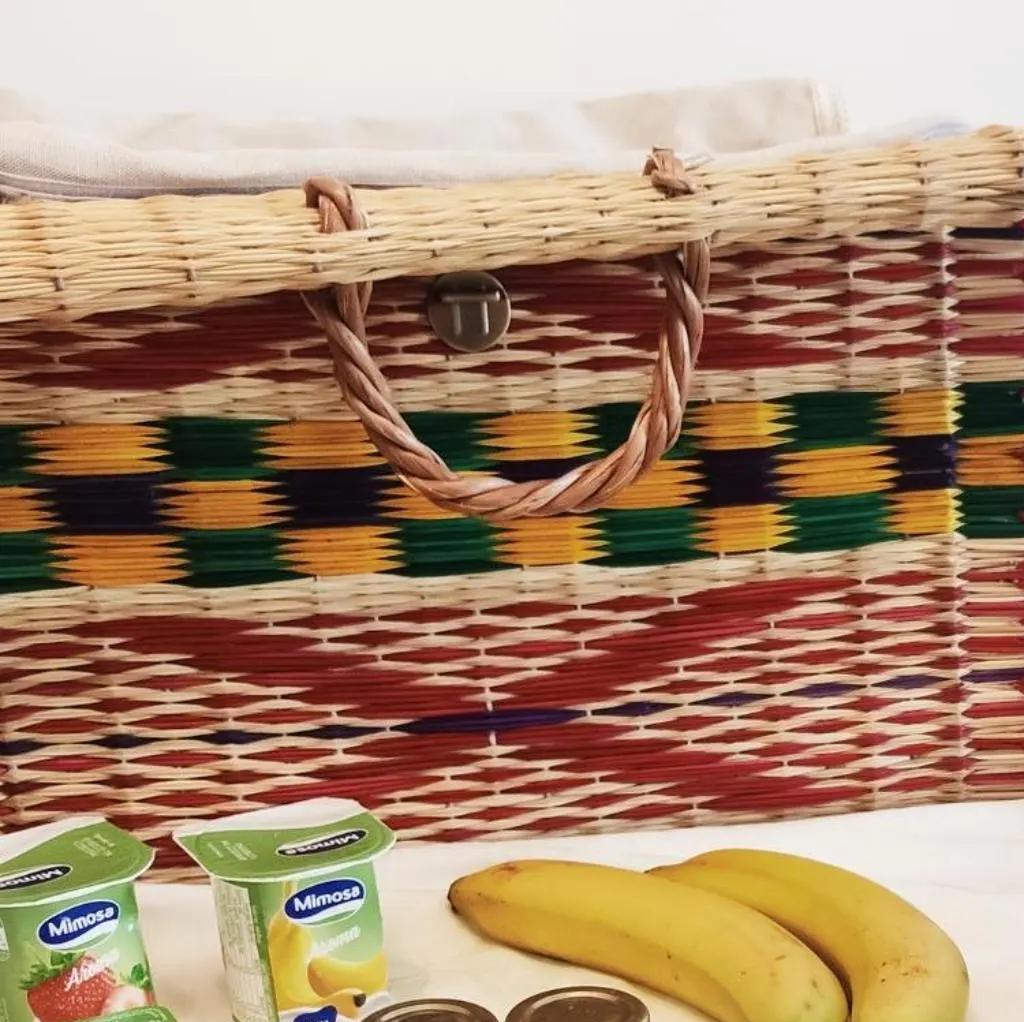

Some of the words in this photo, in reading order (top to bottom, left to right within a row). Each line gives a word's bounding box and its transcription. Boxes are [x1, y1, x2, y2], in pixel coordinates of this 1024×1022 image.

[286, 834, 360, 854] Mimosa
[0, 869, 64, 889] Mimos
[294, 886, 360, 912] Mimosa
[48, 907, 115, 937] Mimosa
